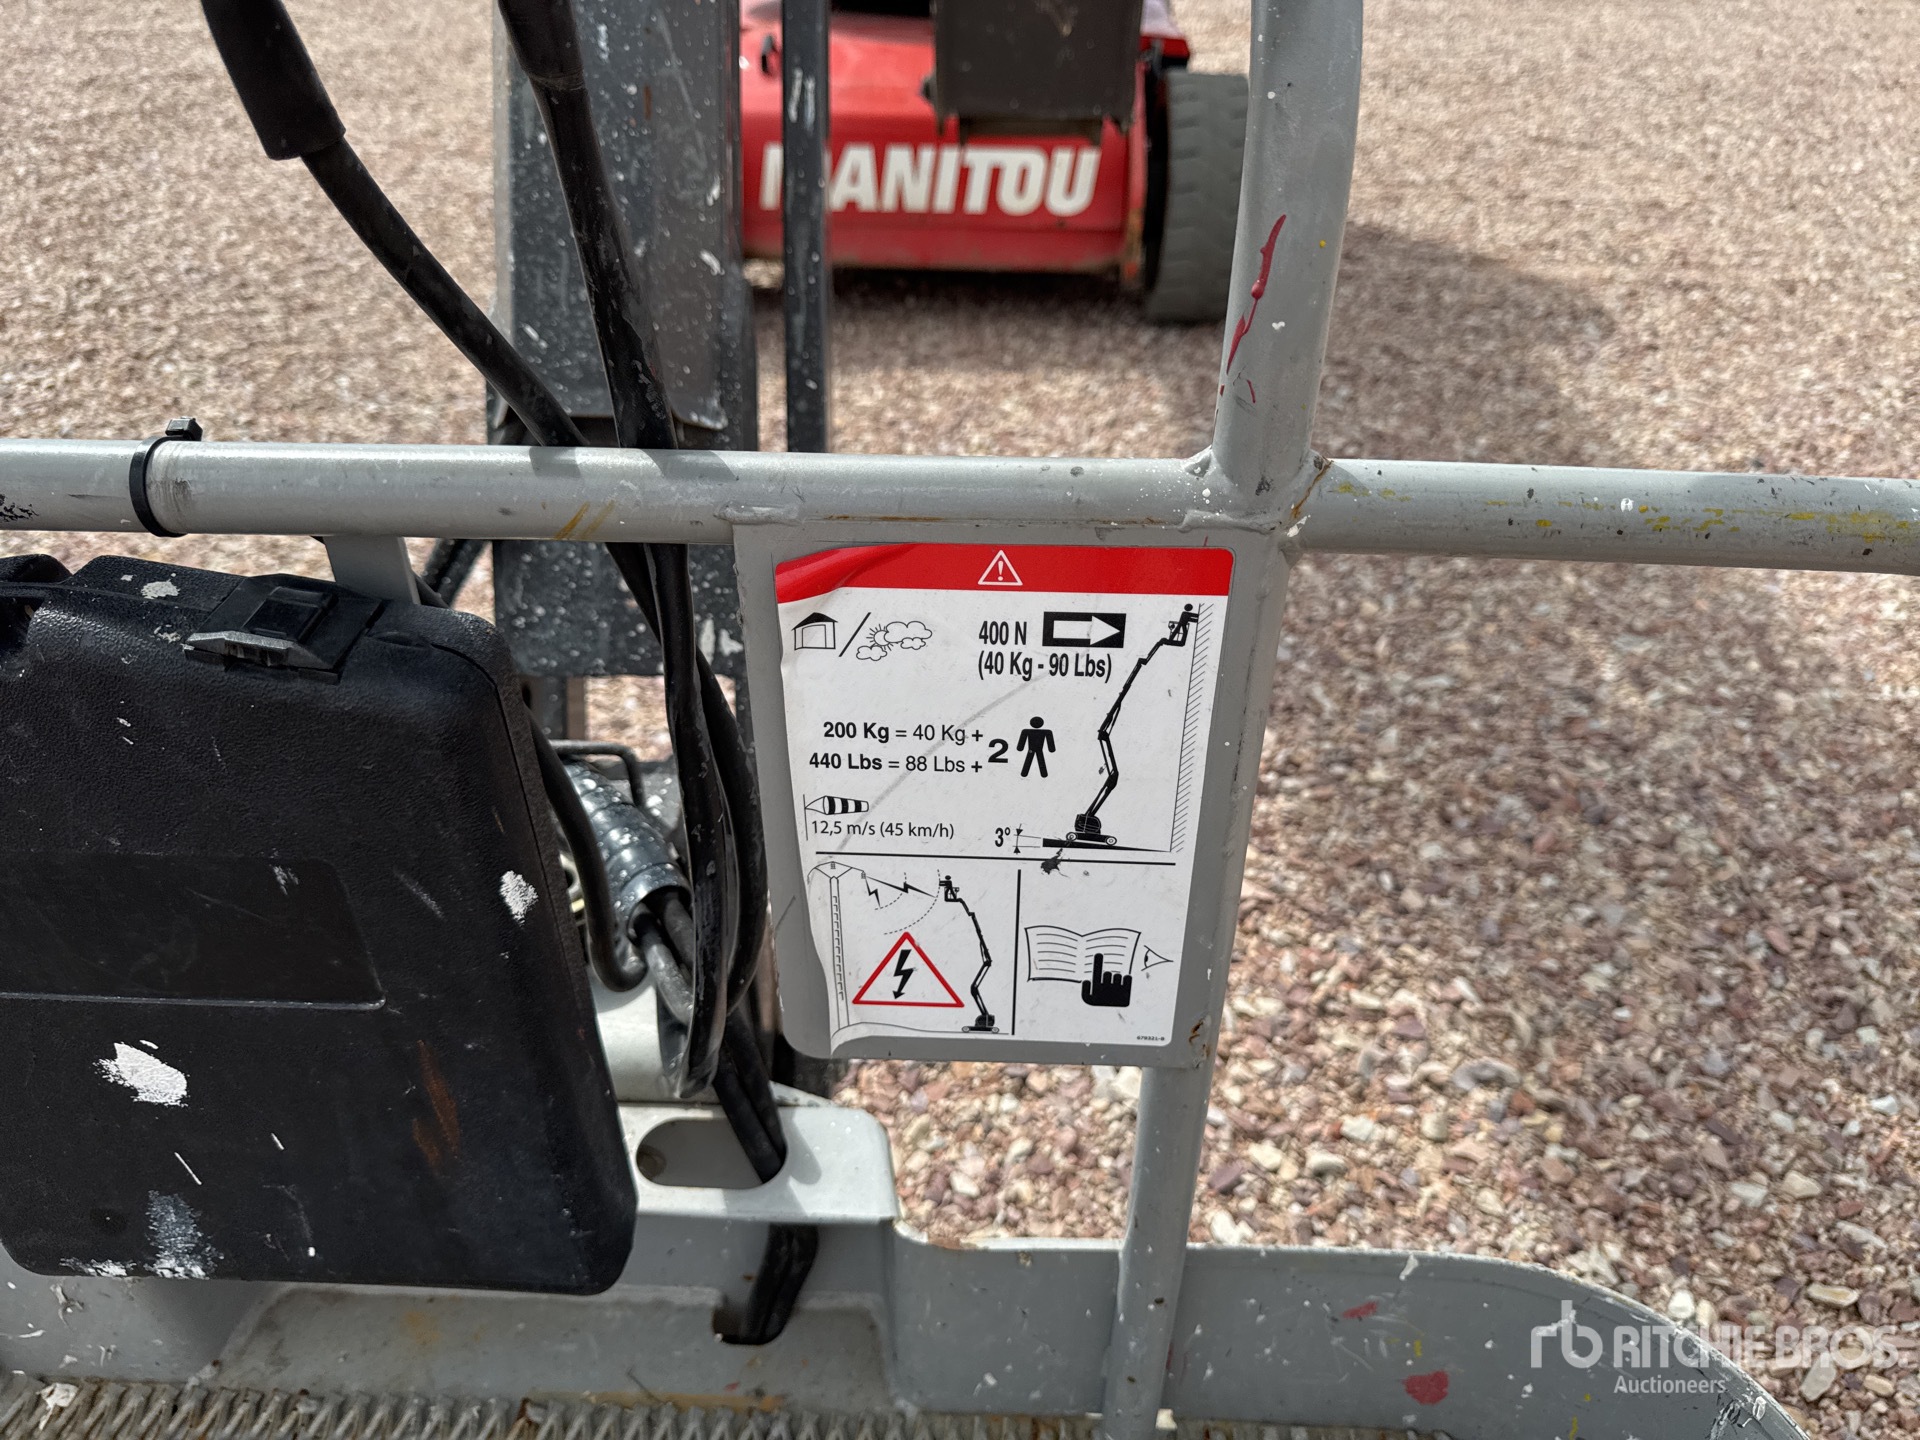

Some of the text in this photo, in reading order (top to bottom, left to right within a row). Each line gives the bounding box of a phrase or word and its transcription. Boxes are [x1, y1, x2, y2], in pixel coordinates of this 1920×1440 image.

[979, 620, 1027, 645] 400 N
[978, 650, 1004, 680] (40
[1010, 652, 1033, 681] Kg
[1049, 653, 1069, 677] 90
[1074, 653, 1112, 683] Lbs)
[823, 721, 857, 739] 200
[863, 722, 890, 743] Kg
[895, 729, 907, 738] =
[913, 724, 935, 740] 40
[941, 724, 966, 746] Kg
[809, 753, 842, 769] 440
[848, 753, 883, 770] Lbs
[888, 760, 900, 769] =
[905, 755, 928, 772] 88
[934, 755, 966, 773] Lbs
[988, 738, 1009, 764] 2
[811, 820, 954, 840] 12,5 m/s (45 km/h)
